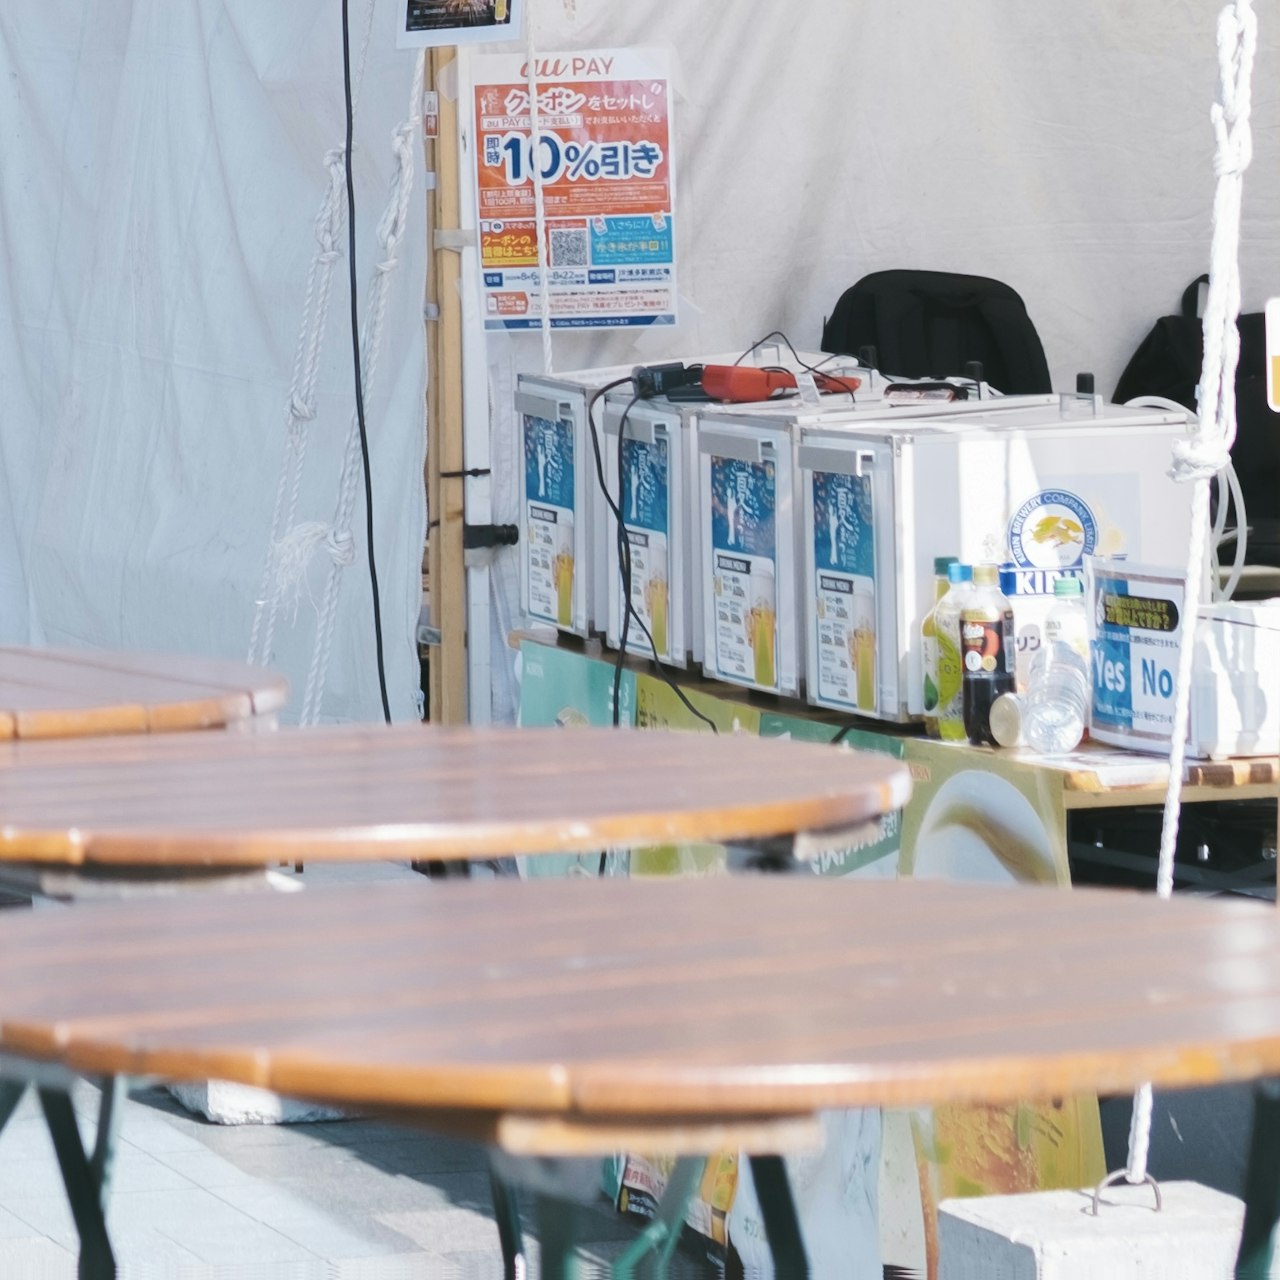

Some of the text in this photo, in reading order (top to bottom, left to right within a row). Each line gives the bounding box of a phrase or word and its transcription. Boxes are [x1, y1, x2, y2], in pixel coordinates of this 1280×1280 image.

[520, 56, 615, 78] au PAY
[504, 135, 660, 180] 10%引き
[1043, 493, 1089, 522] COMPANY
[1094, 648, 1126, 693] Yes
[1141, 658, 1174, 699] No
